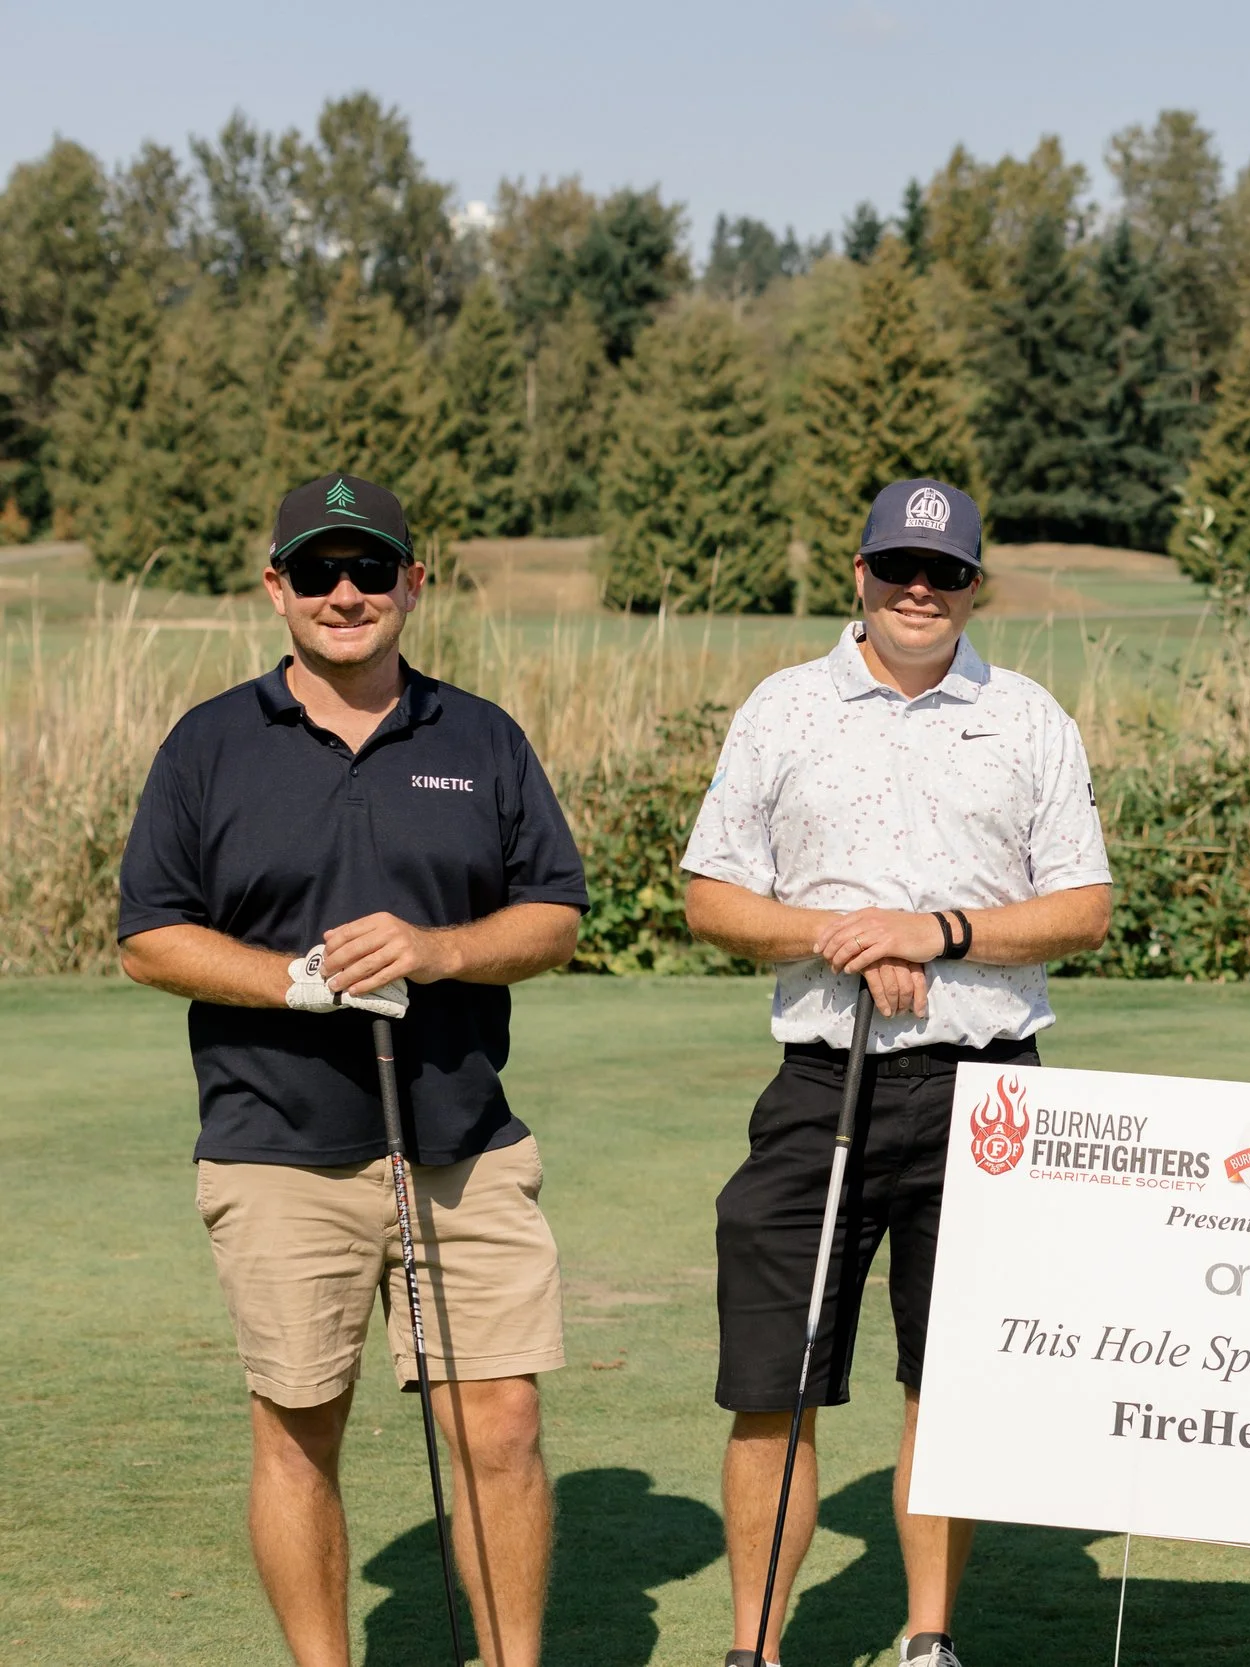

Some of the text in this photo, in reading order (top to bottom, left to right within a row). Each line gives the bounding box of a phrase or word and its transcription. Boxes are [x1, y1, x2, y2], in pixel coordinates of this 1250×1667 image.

[910, 498, 944, 520] 40
[908, 519, 944, 530] KINETIC
[411, 775, 474, 792] KINETIC
[1035, 1109, 1148, 1142] BURNABY
[1031, 1139, 1210, 1179] FIREFIGHTERS
[1029, 1169, 1206, 1192] CHARITABLE SOCIETY
[997, 1318, 1081, 1358] This
[1091, 1326, 1191, 1367] Hole
